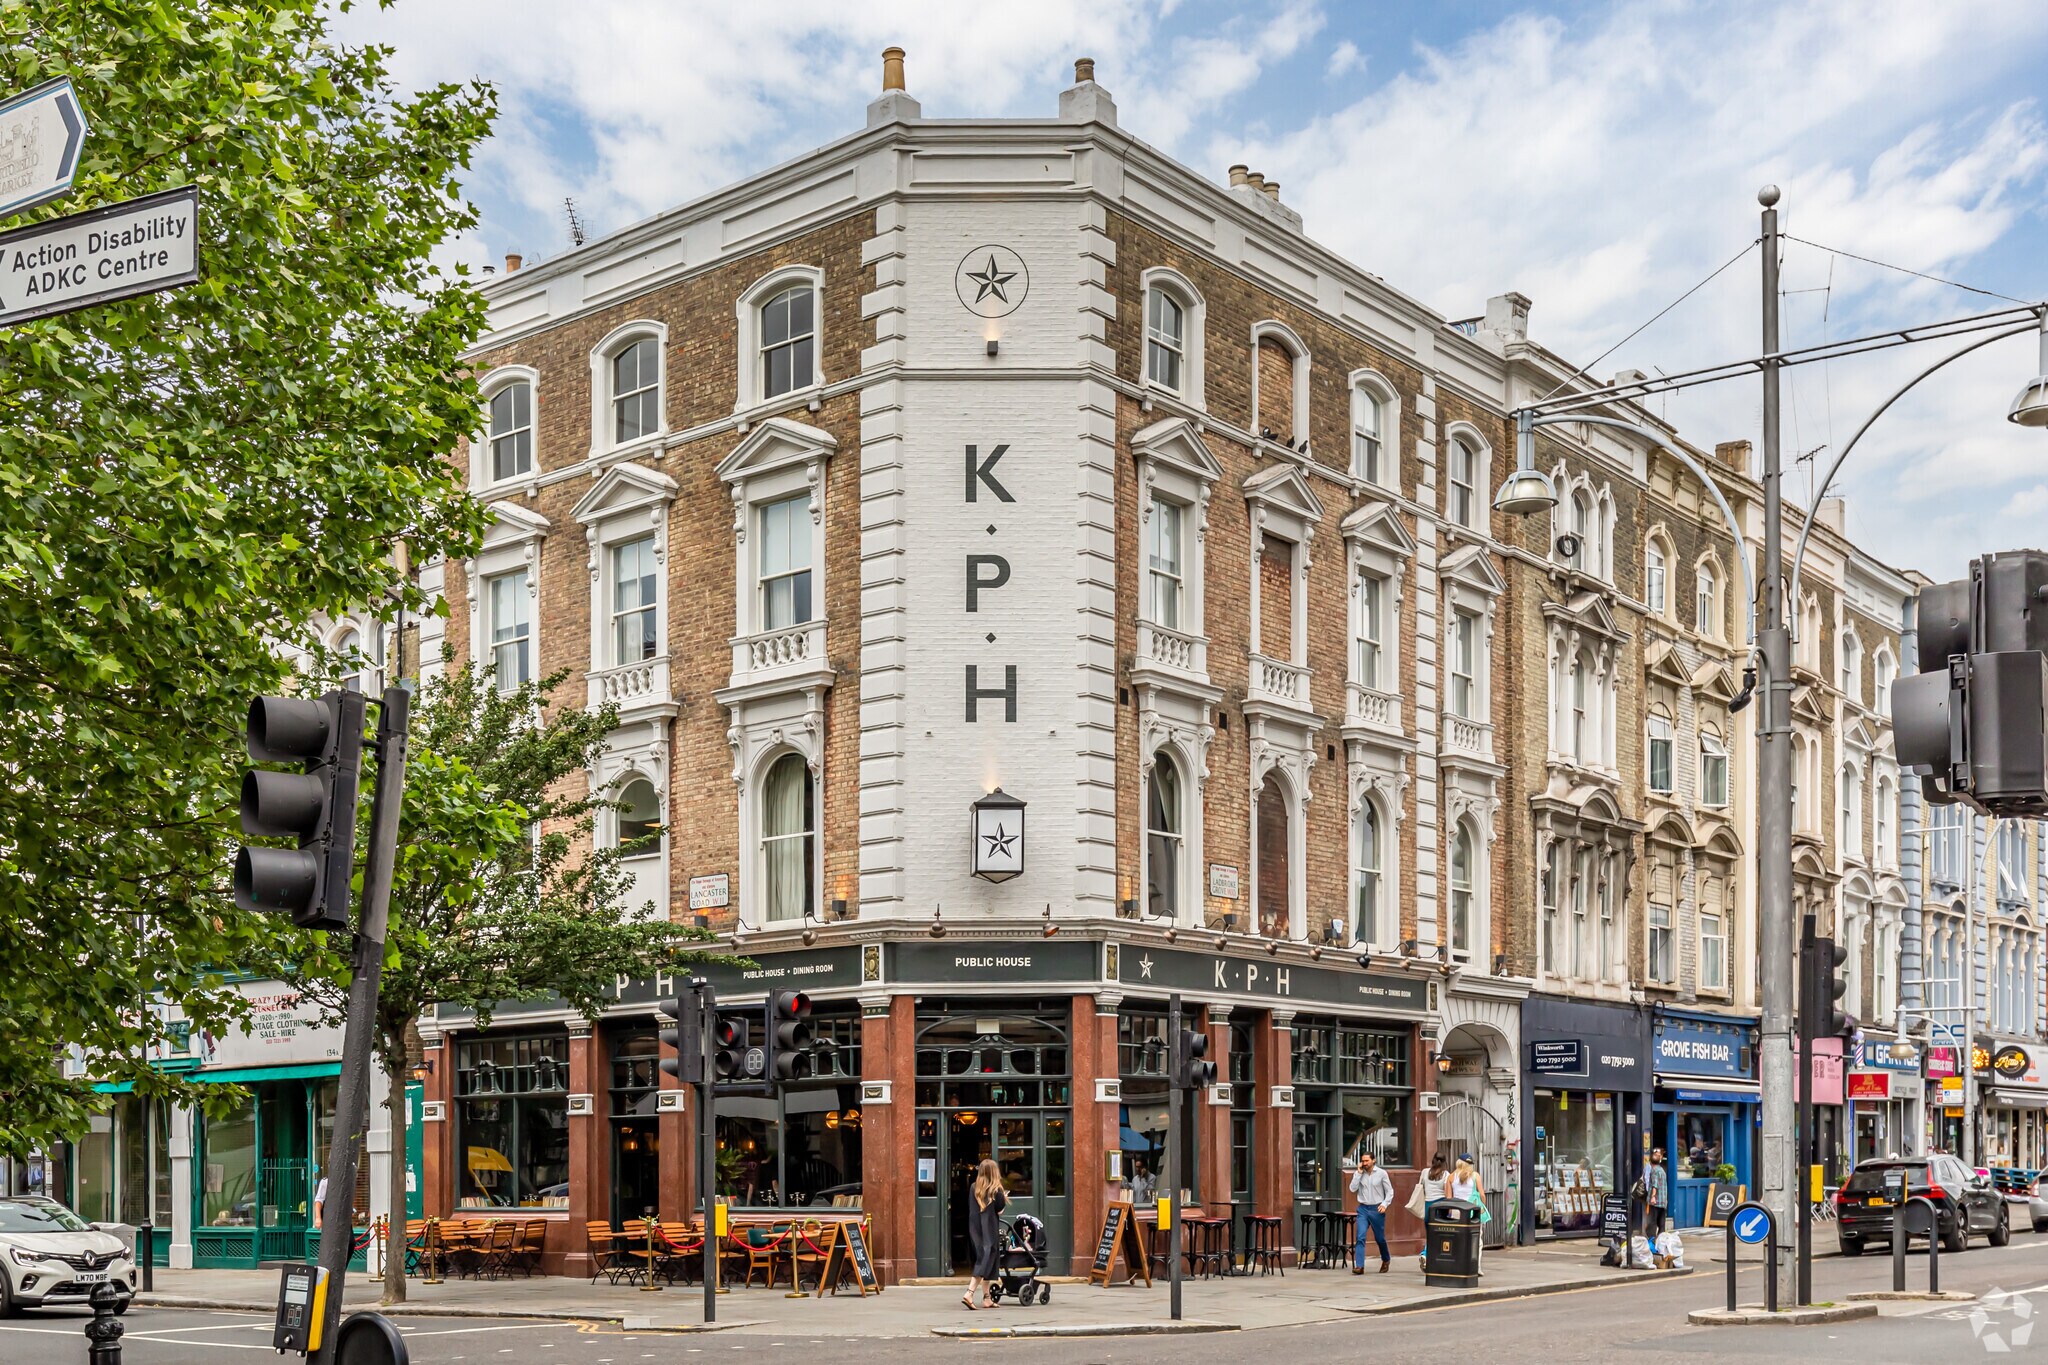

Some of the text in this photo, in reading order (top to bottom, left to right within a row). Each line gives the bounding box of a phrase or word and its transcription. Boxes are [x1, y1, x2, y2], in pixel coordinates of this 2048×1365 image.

[12, 215, 187, 272] Action Disability
[26, 249, 169, 297] ADKC Centre
[965, 444, 1017, 502] K
[966, 554, 1011, 612] P
[965, 664, 1017, 722] H
[691, 888, 727, 899] LANCASTER
[692, 899, 710, 908] ROAD
[743, 969, 764, 979] PUBLIC
[765, 968, 785, 977] HOUSE
[793, 966, 815, 975] DINING
[816, 964, 834, 973] ROOM
[955, 957, 1031, 967] PUBLIC HOUSE
[1215, 960, 1290, 995] K P H
[1661, 1039, 1729, 1061] GROVE FISH BAR
[1601, 1056, 1635, 1068] 020 7792 5000
[1605, 1212, 1627, 1222] OPEN
